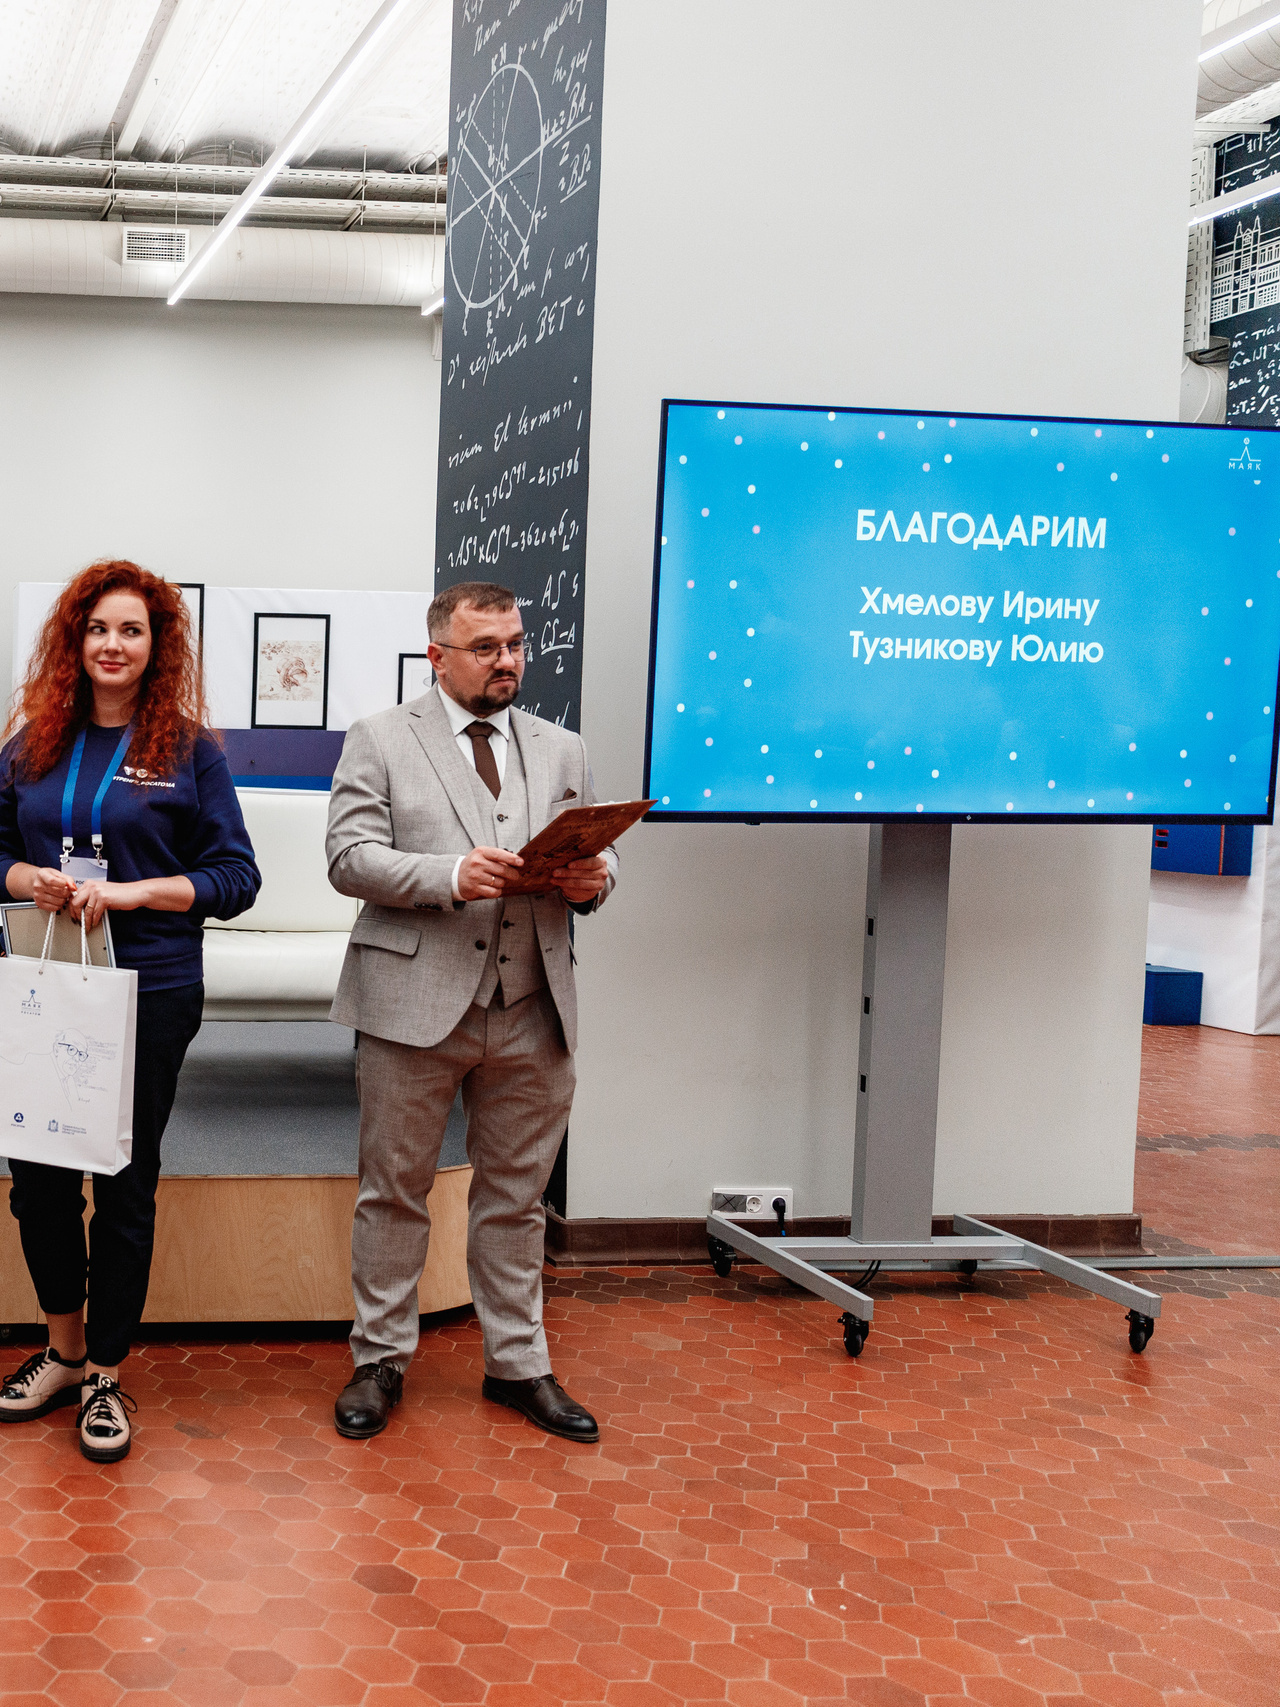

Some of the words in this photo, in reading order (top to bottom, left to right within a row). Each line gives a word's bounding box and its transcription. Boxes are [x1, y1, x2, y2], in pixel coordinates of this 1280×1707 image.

[1228, 462, 1261, 470] МАЯК
[855, 509, 1107, 551] БЛАГОДАРИМ
[859, 587, 994, 624] Хмелову
[1002, 590, 1100, 626] Ирину
[849, 630, 1002, 668] Тузникову
[1011, 634, 1104, 664] Юлию
